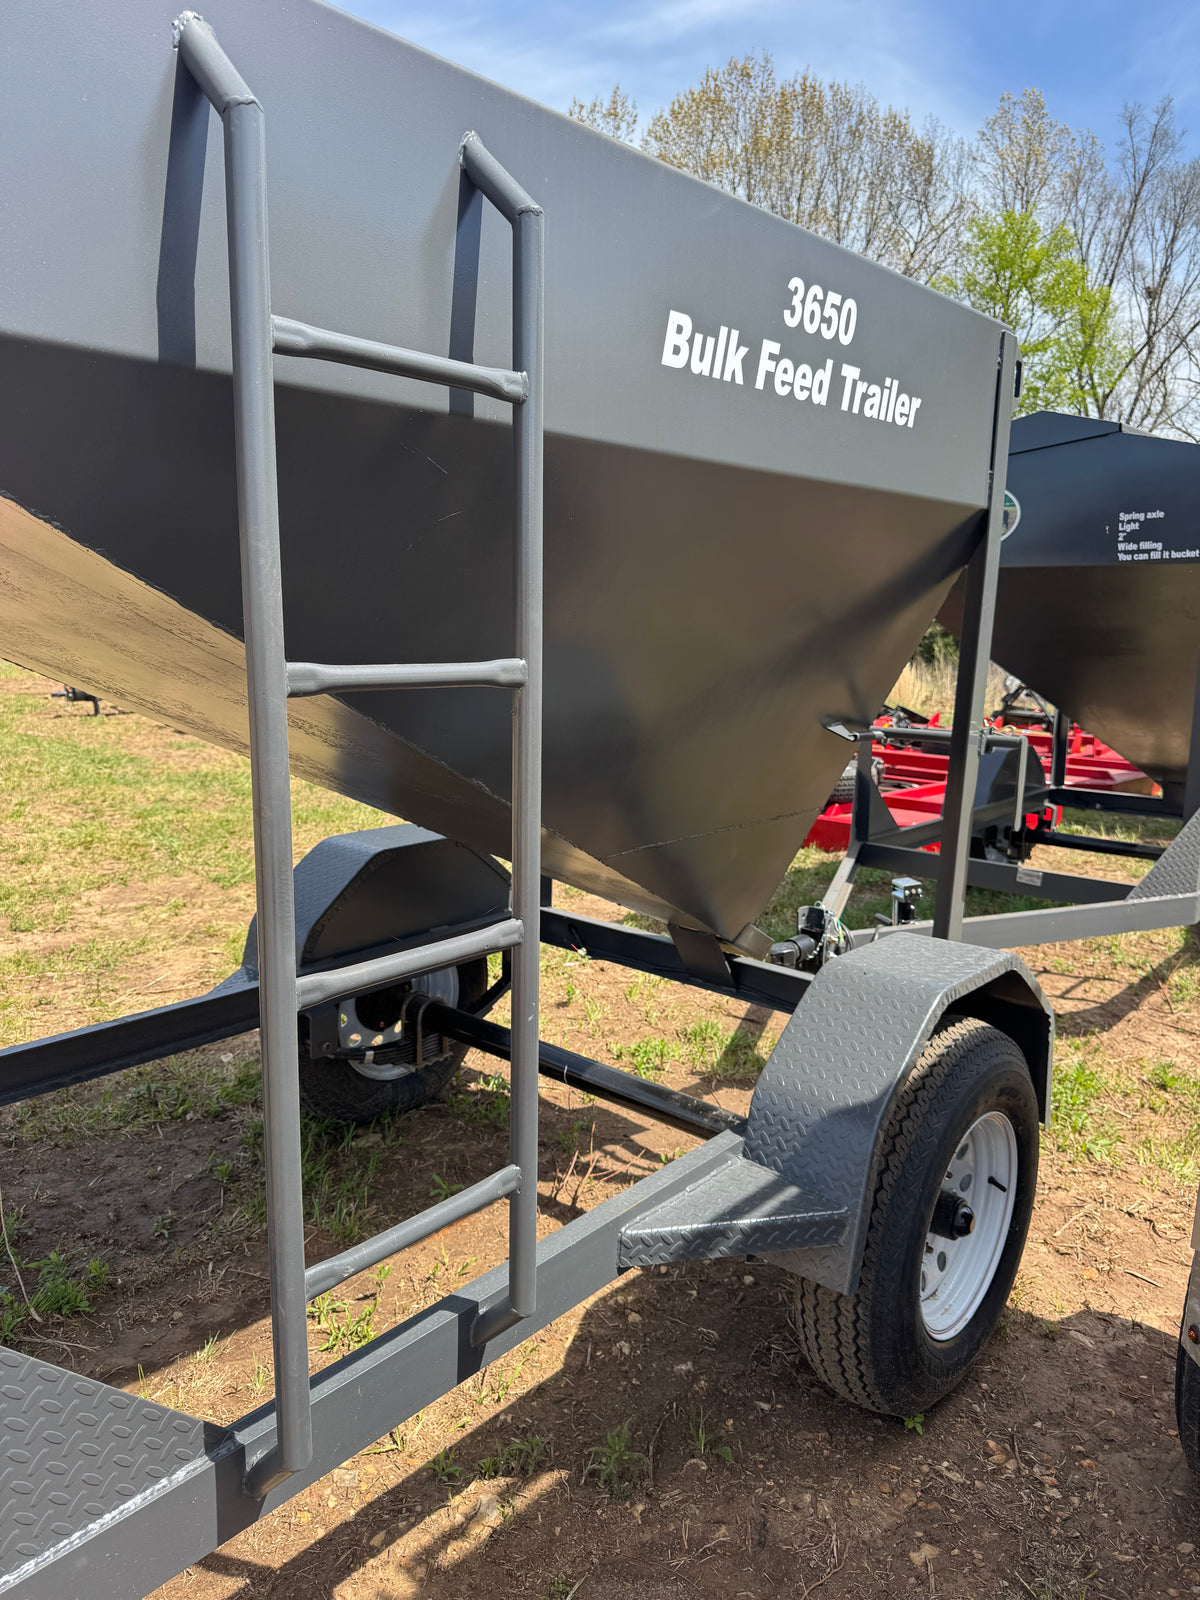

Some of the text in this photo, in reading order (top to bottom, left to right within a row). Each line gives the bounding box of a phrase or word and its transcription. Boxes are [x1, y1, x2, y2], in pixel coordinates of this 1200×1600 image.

[783, 276, 858, 346] 3650
[661, 309, 922, 428] Bulk Feed Trailer
[1119, 509, 1165, 522] Spring axle
[1118, 522, 1140, 532] Light
[1117, 541, 1163, 551] Wide filling
[1117, 552, 1133, 561] You
[1150, 551, 1161, 560] fill
[1162, 550, 1170, 559] it
[1170, 549, 1200, 559] bucket
